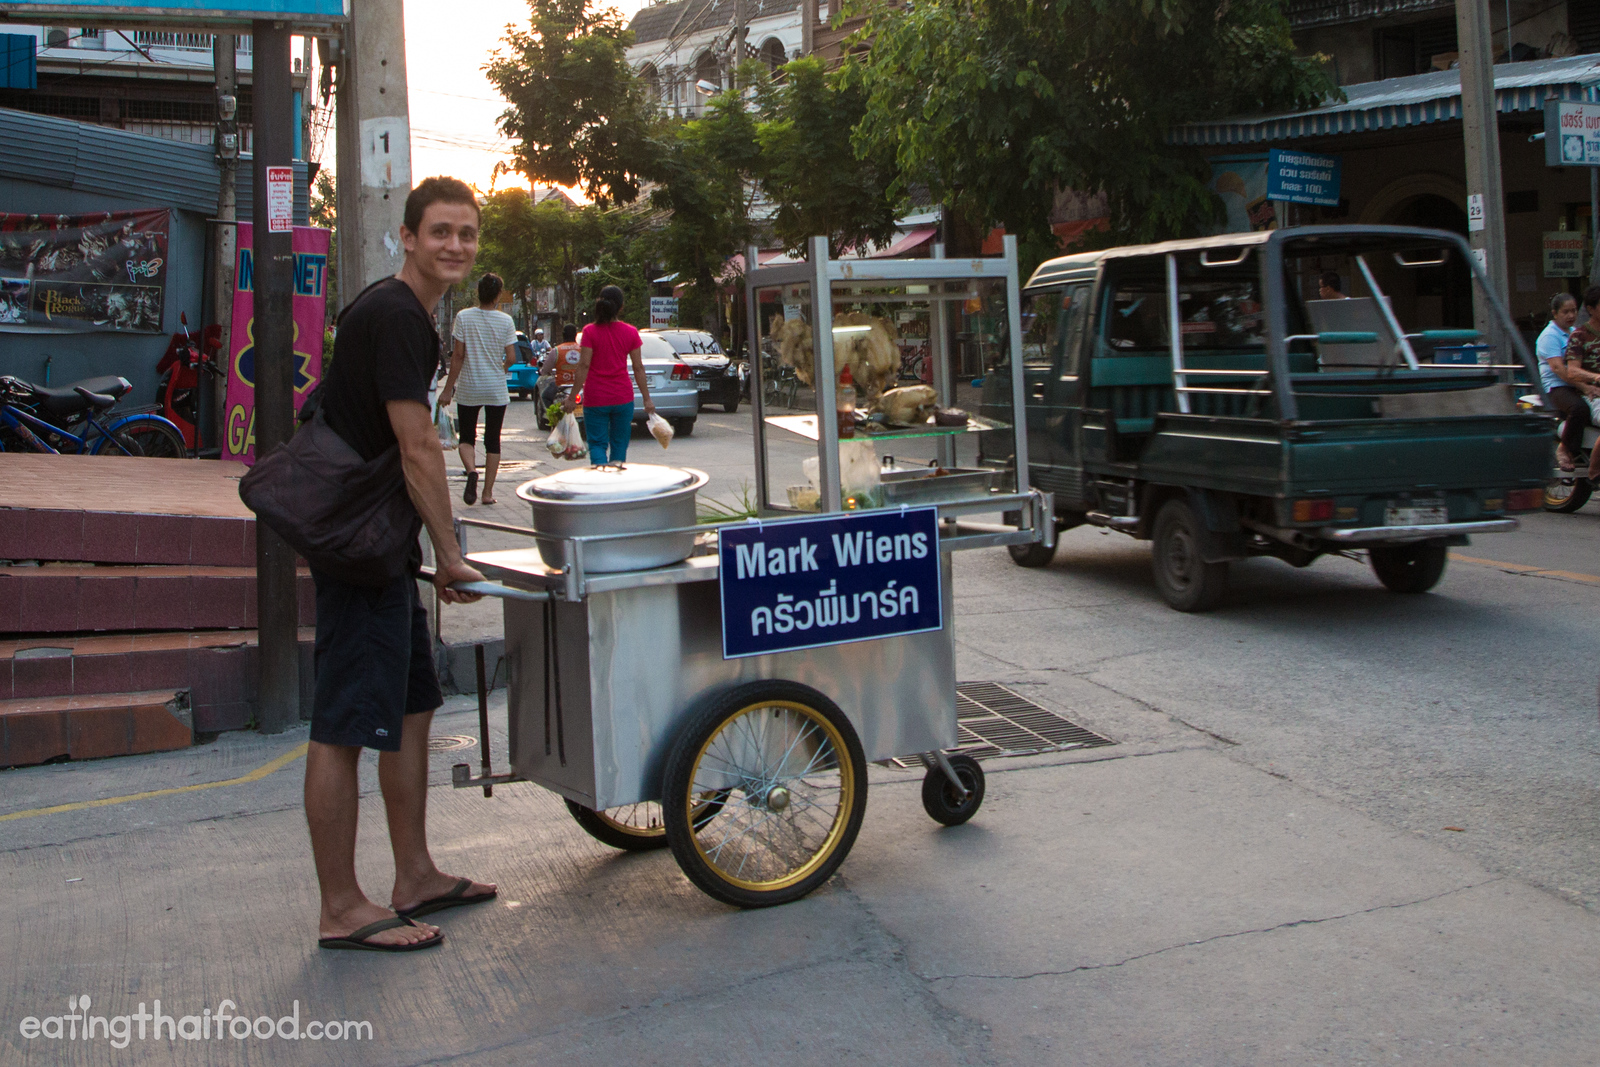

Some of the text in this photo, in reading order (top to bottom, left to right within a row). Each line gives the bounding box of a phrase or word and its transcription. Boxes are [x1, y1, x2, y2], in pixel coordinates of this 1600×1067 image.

[1470, 207, 1481, 216] 29
[39, 289, 82, 305] Black
[735, 531, 928, 580] Mark Wiens
[751, 579, 920, 637] ครัวพี่มาร์ค
